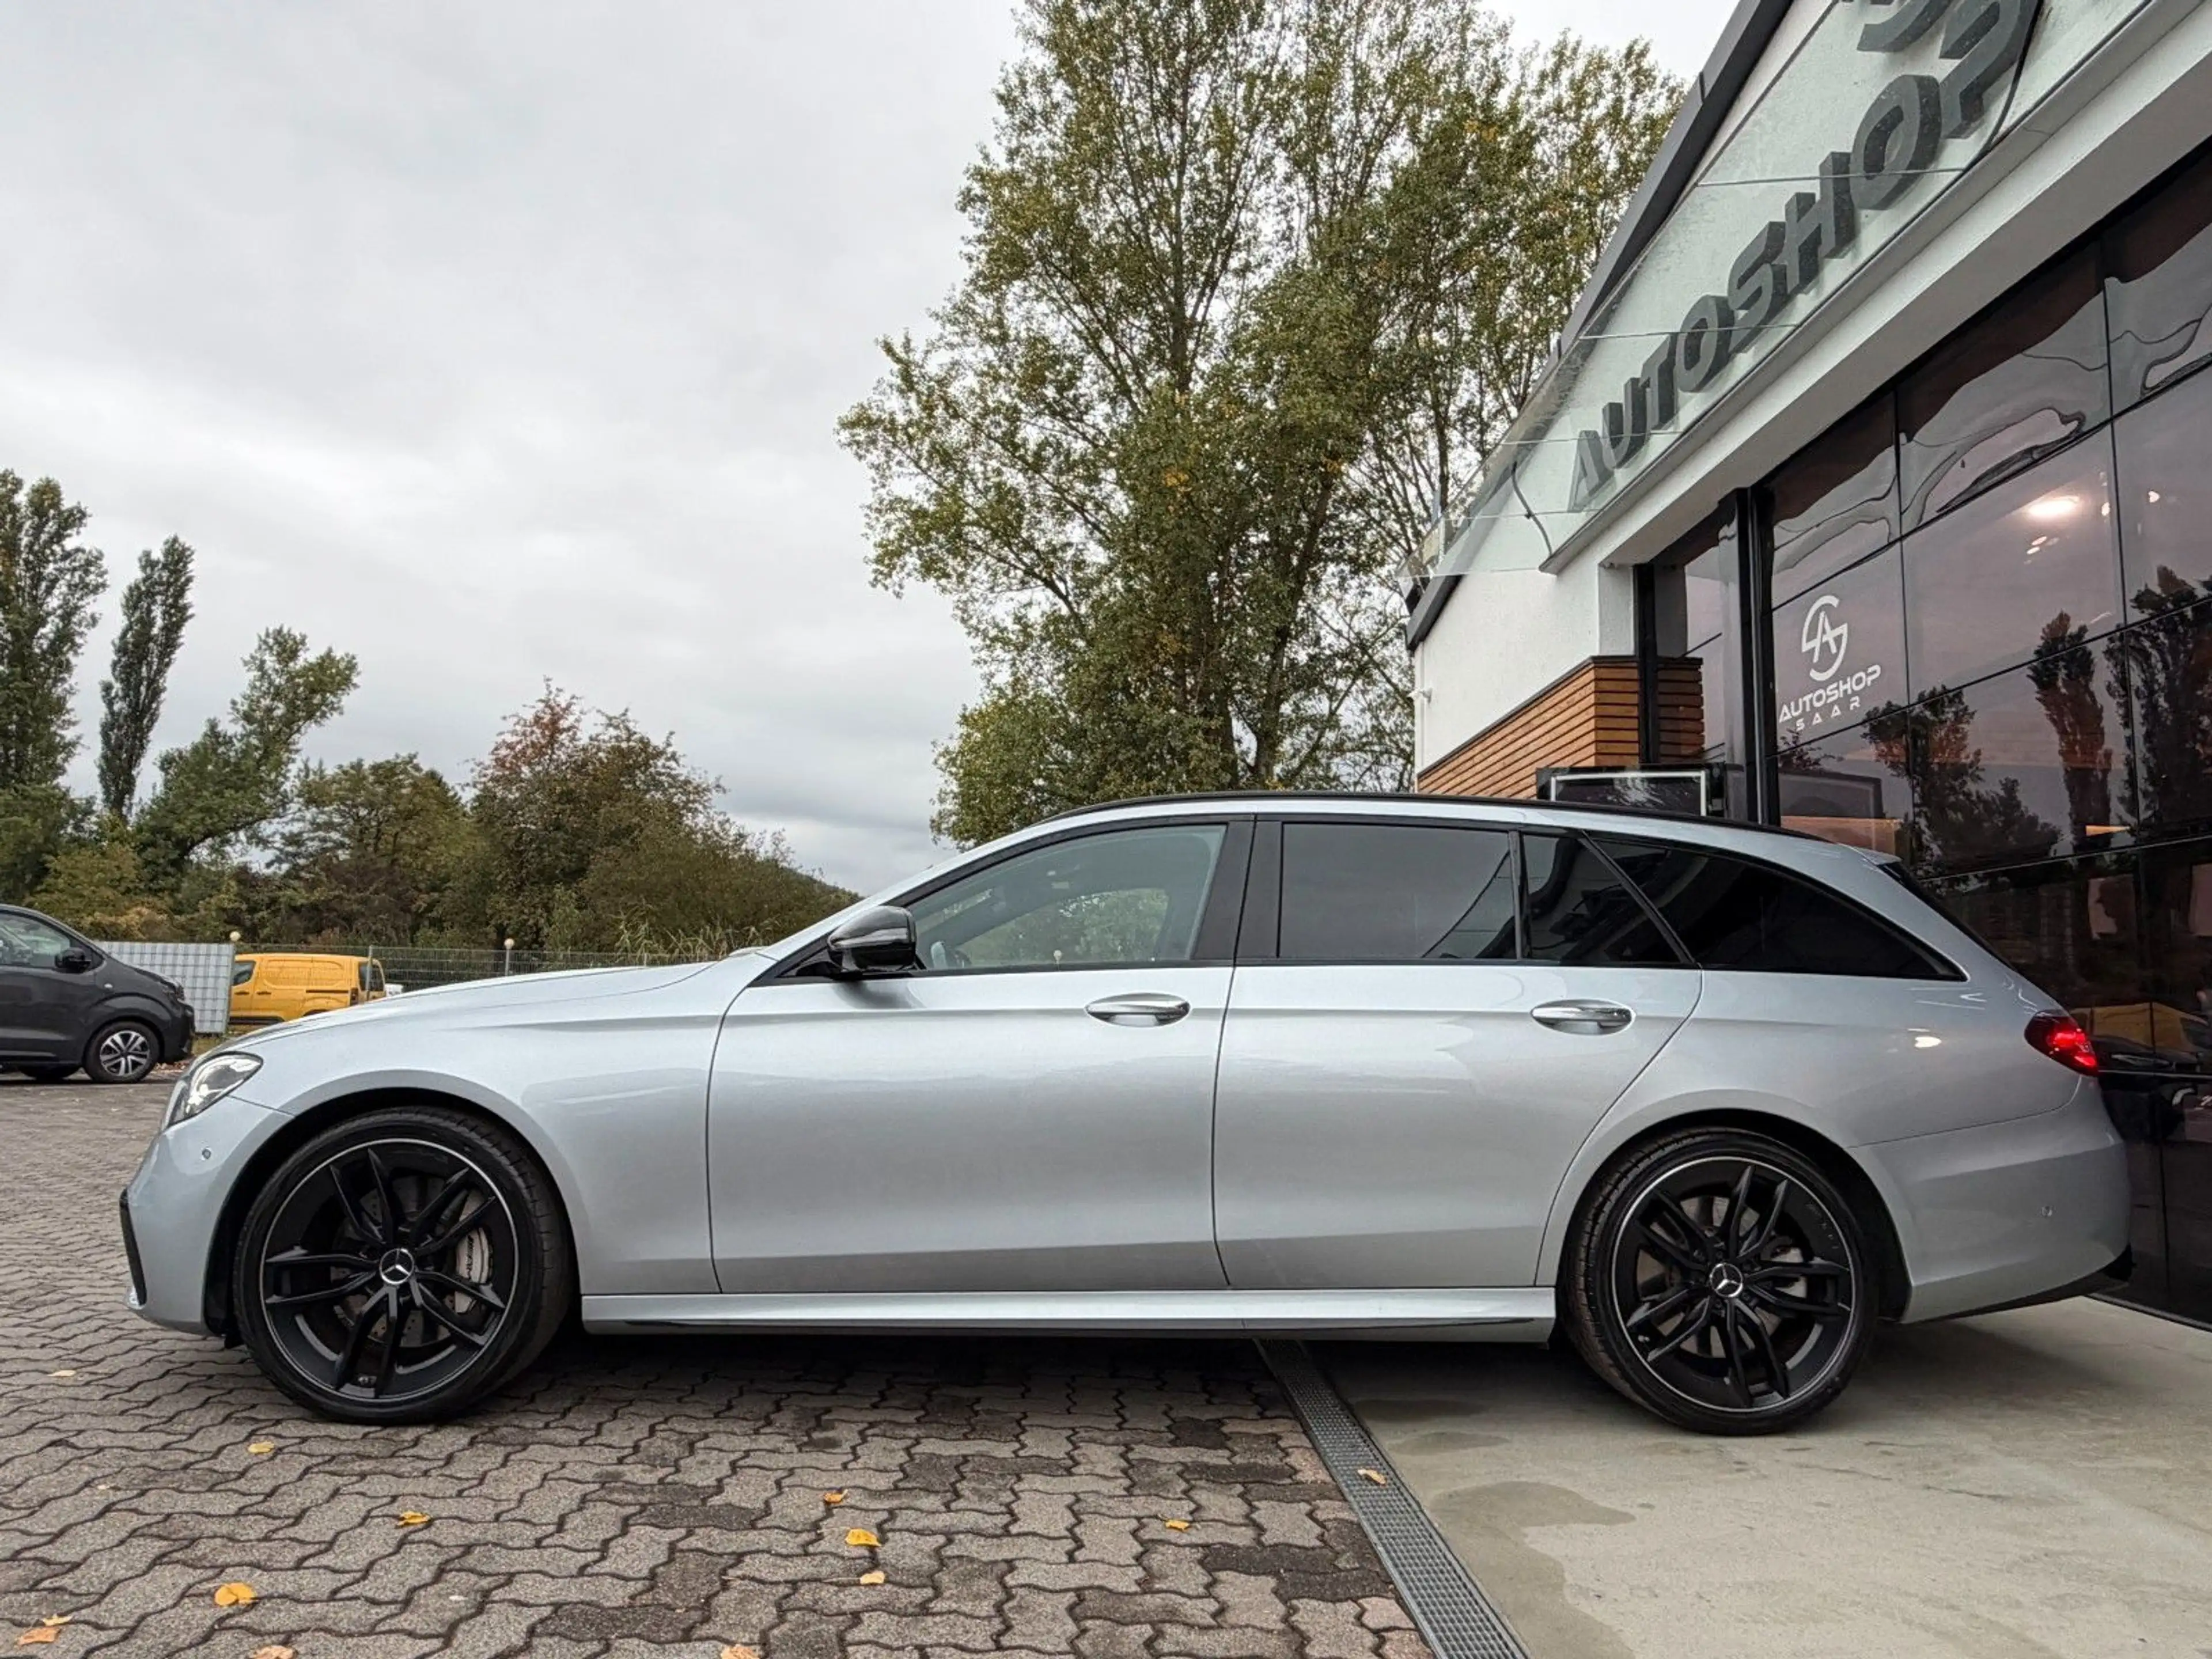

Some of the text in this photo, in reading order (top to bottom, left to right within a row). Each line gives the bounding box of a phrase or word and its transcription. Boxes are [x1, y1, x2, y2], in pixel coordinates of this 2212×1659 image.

[1567, 0, 2042, 513] AUTOSHOP
[1779, 664, 1881, 723] AUTOSHOP
[1796, 695, 1861, 732] SAAR
